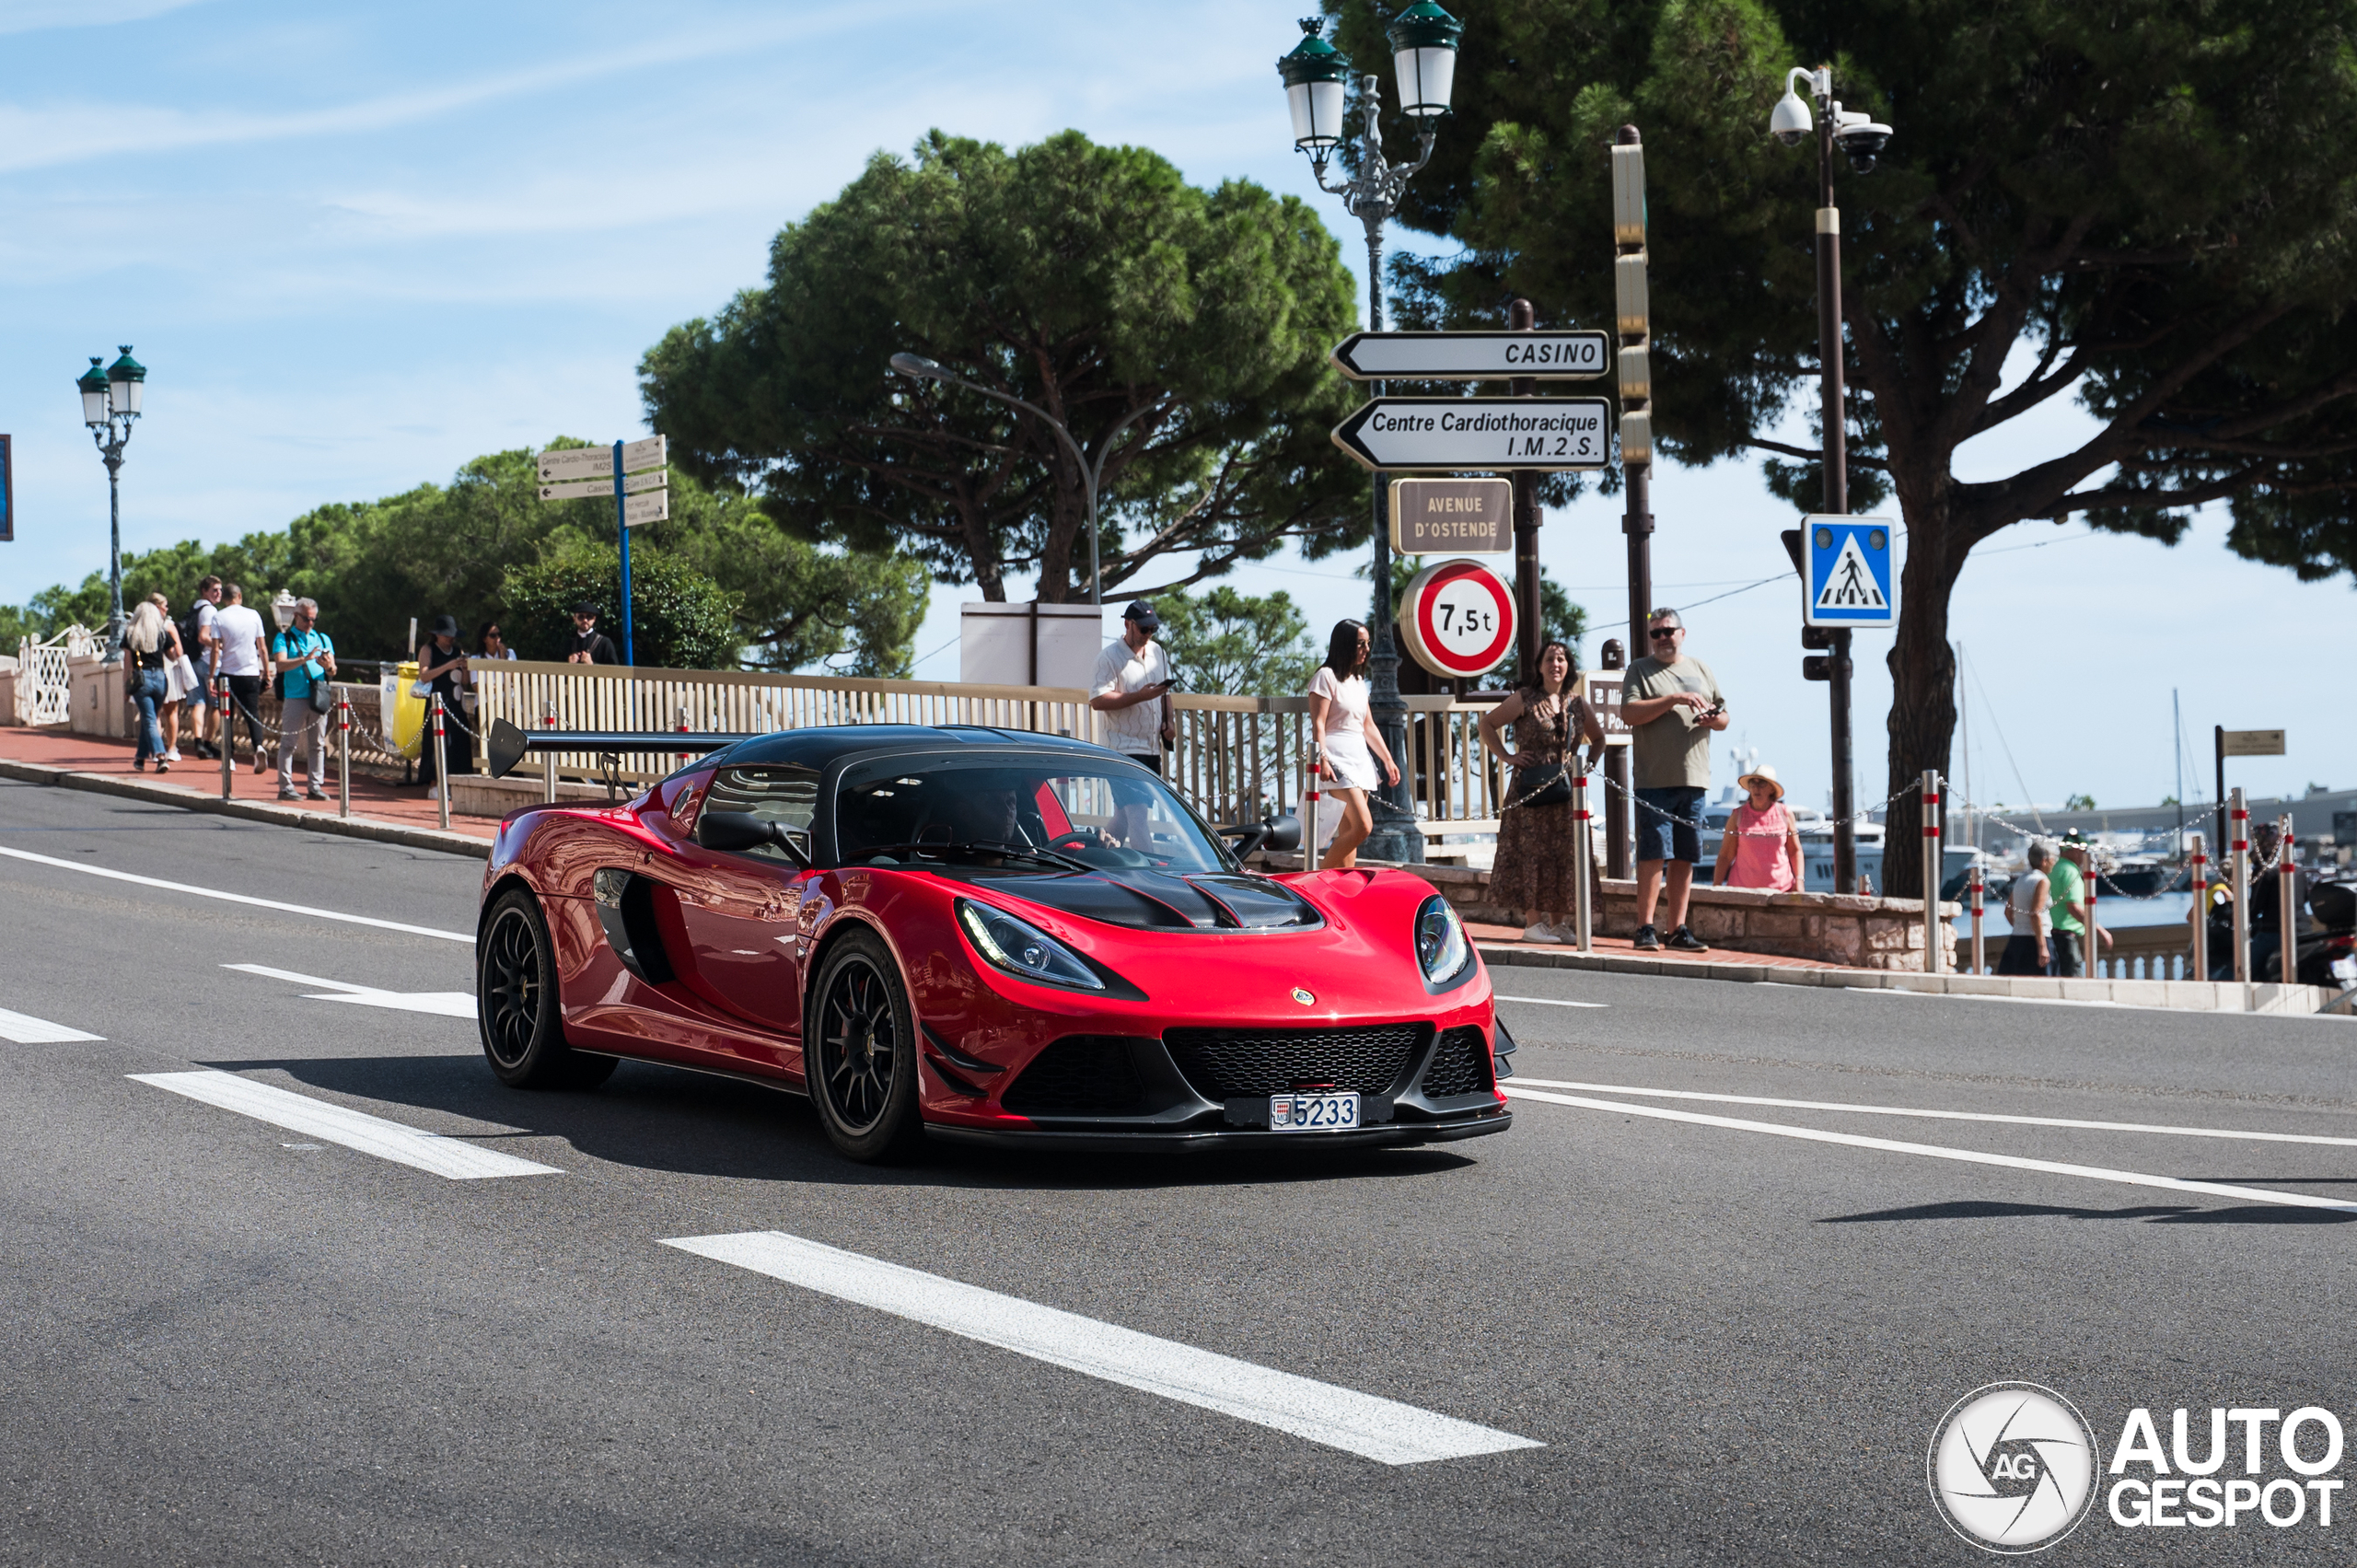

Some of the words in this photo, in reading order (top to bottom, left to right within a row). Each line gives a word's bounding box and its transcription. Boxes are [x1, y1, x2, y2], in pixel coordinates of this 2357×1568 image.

[1505, 343, 1596, 364] CASINO
[1371, 412, 1434, 432] Centre
[1441, 412, 1598, 436] Cardiothoracique
[1507, 436, 1599, 456] I.M.2.S.
[586, 484, 612, 493] Casino
[1428, 497, 1483, 512] AVENUE
[1415, 521, 1497, 538] D'OSTENDE
[1295, 1098, 1353, 1126] 5233
